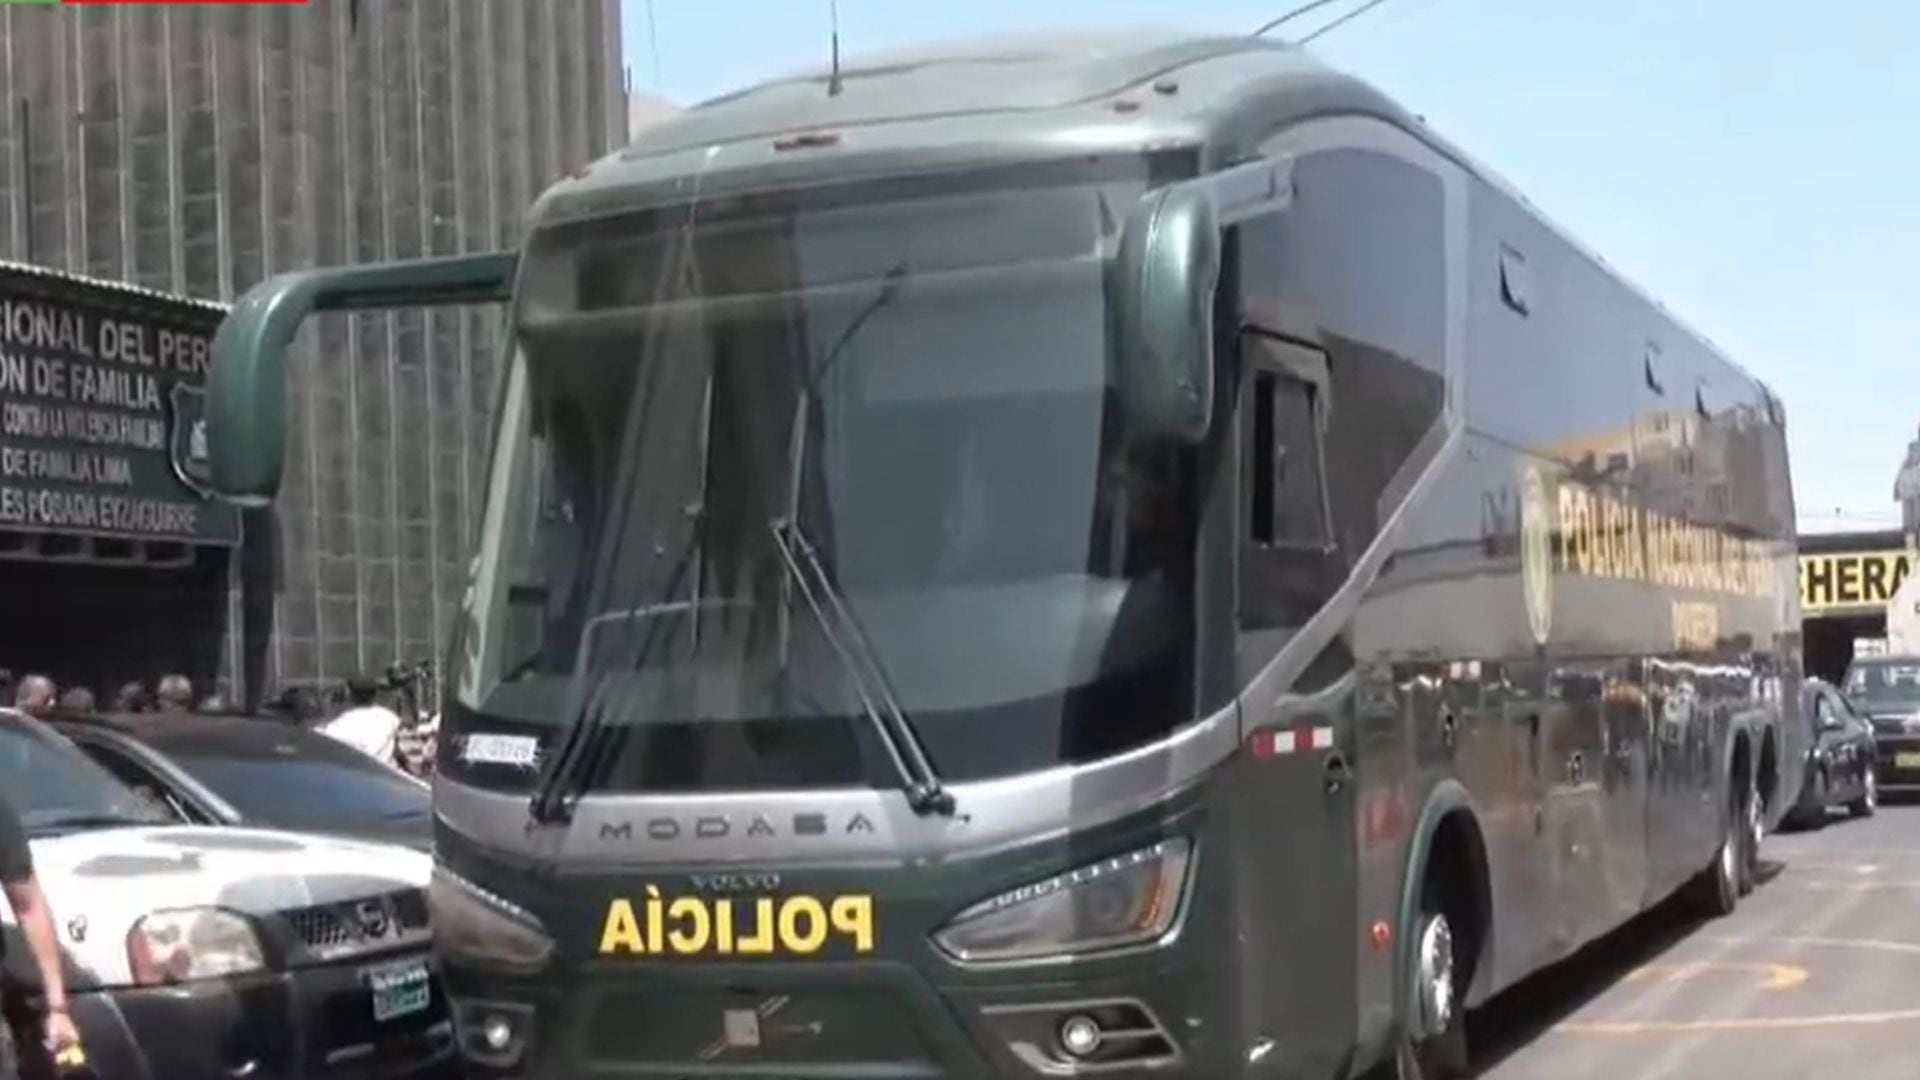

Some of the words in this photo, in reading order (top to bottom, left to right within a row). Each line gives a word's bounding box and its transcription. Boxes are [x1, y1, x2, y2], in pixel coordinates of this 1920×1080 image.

[0, 300, 93, 356] IONAL
[100, 318, 154, 366] DEL
[157, 328, 210, 374] PER
[33, 356, 67, 399] DE
[70, 363, 161, 412] FAMILIA
[2, 446, 27, 476] DE
[29, 451, 93, 483] FAMILIA
[94, 456, 133, 487] LIMA
[0, 486, 26, 521] ES
[28, 488, 99, 527] POSADA
[1799, 555, 1910, 604] HERA
[599, 811, 875, 841] MODASA
[690, 873, 781, 891] VOLVO
